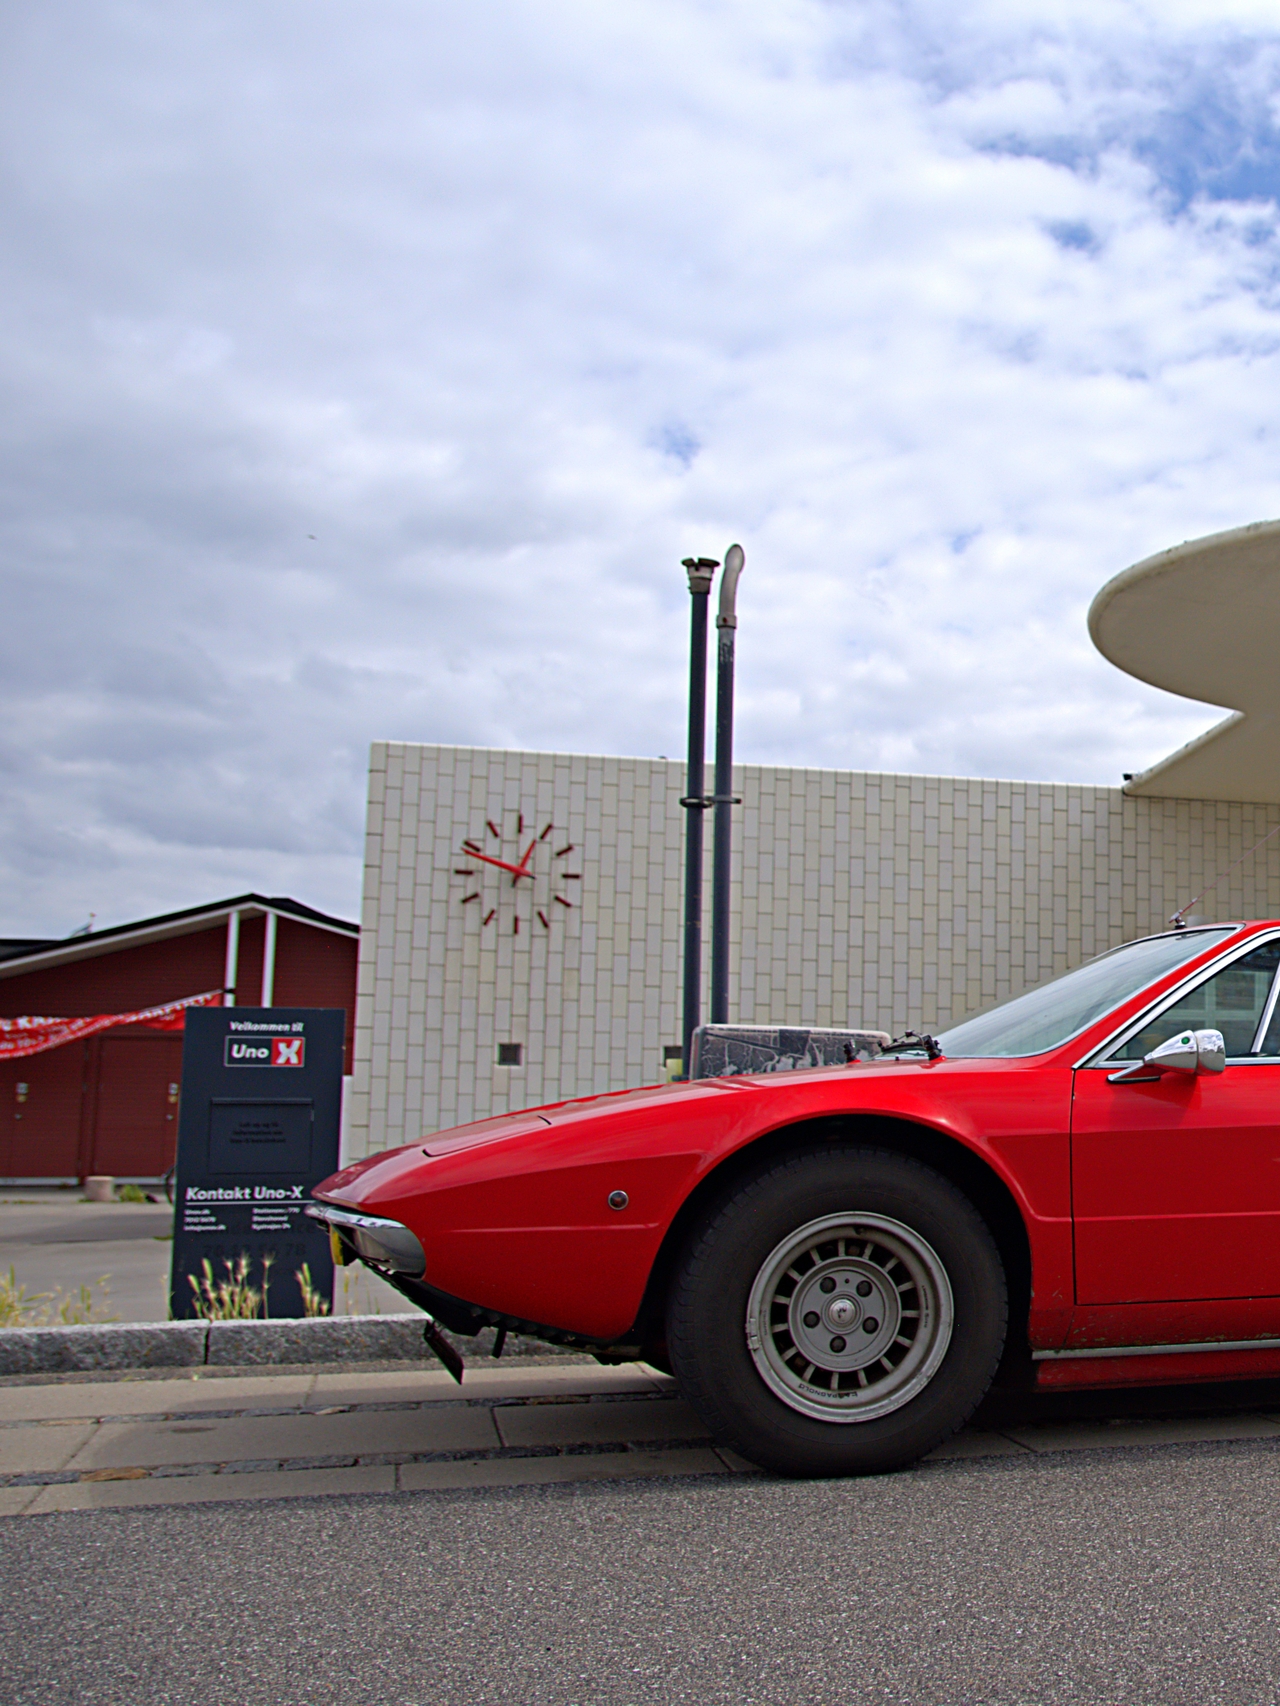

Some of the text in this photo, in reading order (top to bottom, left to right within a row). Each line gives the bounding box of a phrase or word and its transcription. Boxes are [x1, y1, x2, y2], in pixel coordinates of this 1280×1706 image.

[229, 1021, 304, 1032] Velkommen til
[231, 1039, 302, 1064] Uno X
[185, 1185, 304, 1200] Kontakt Uno-X
